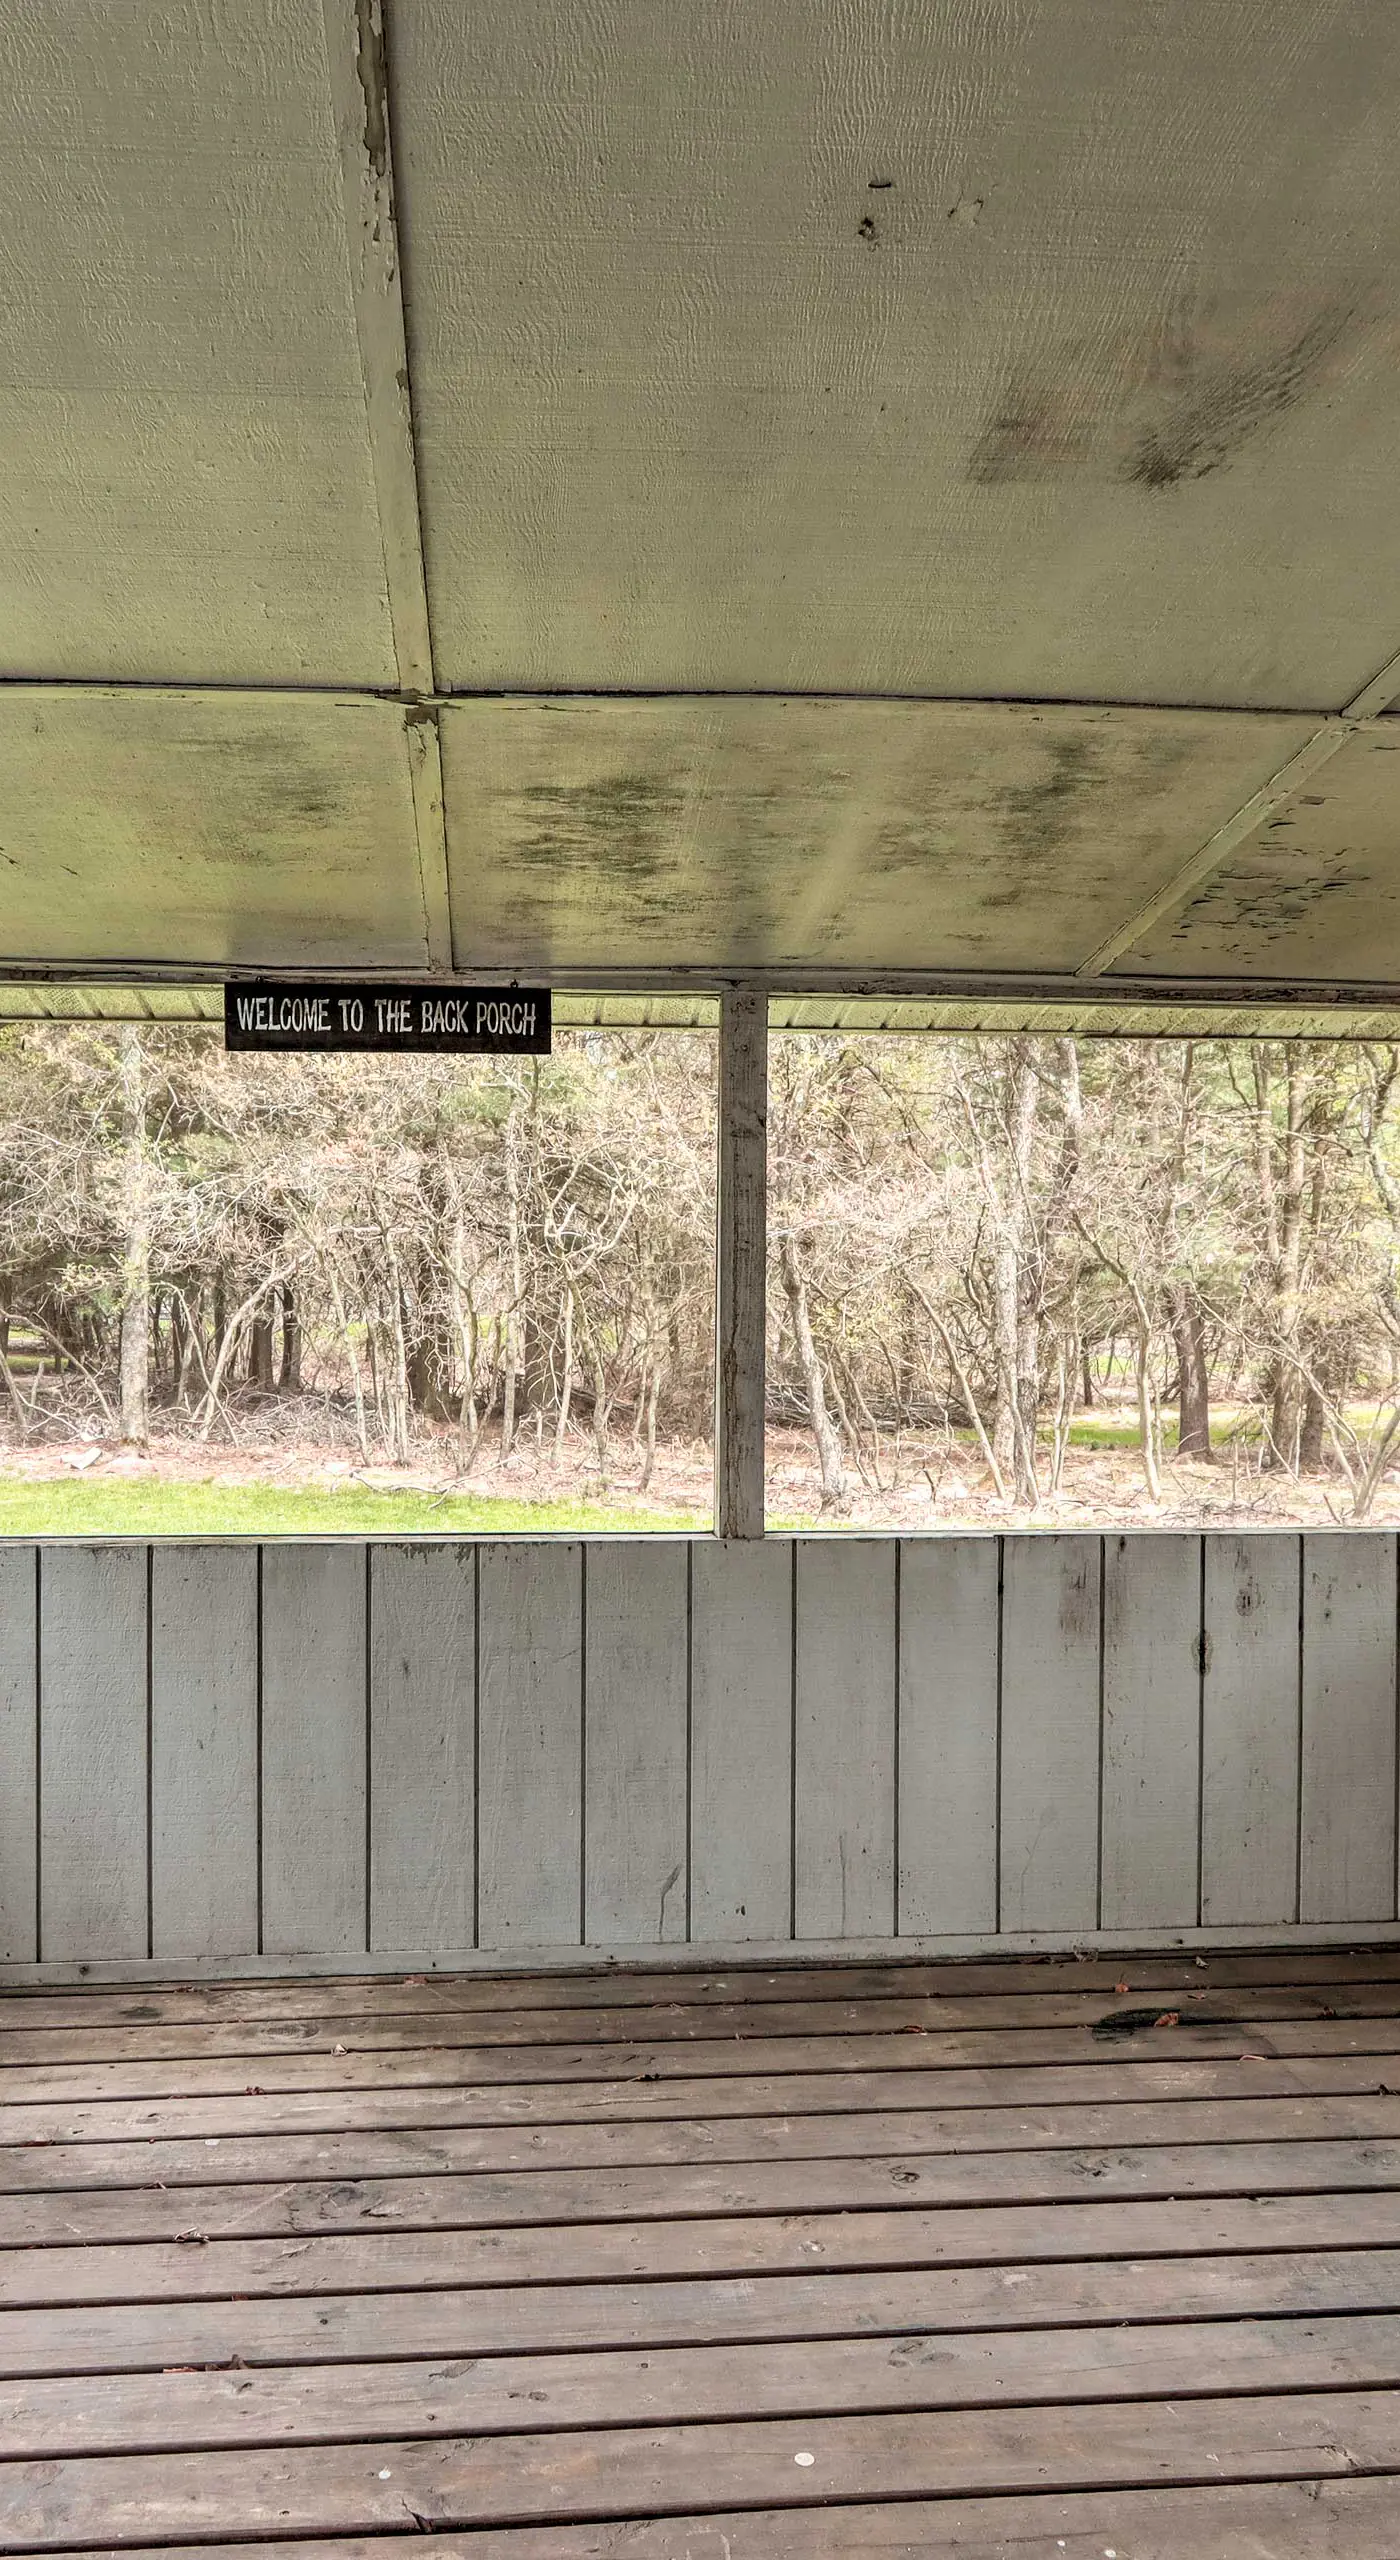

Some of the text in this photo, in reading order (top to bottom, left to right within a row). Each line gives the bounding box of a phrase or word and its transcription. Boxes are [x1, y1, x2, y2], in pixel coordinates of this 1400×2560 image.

[236, 997, 536, 1035] WELCOME TO THE BACK PORCH
